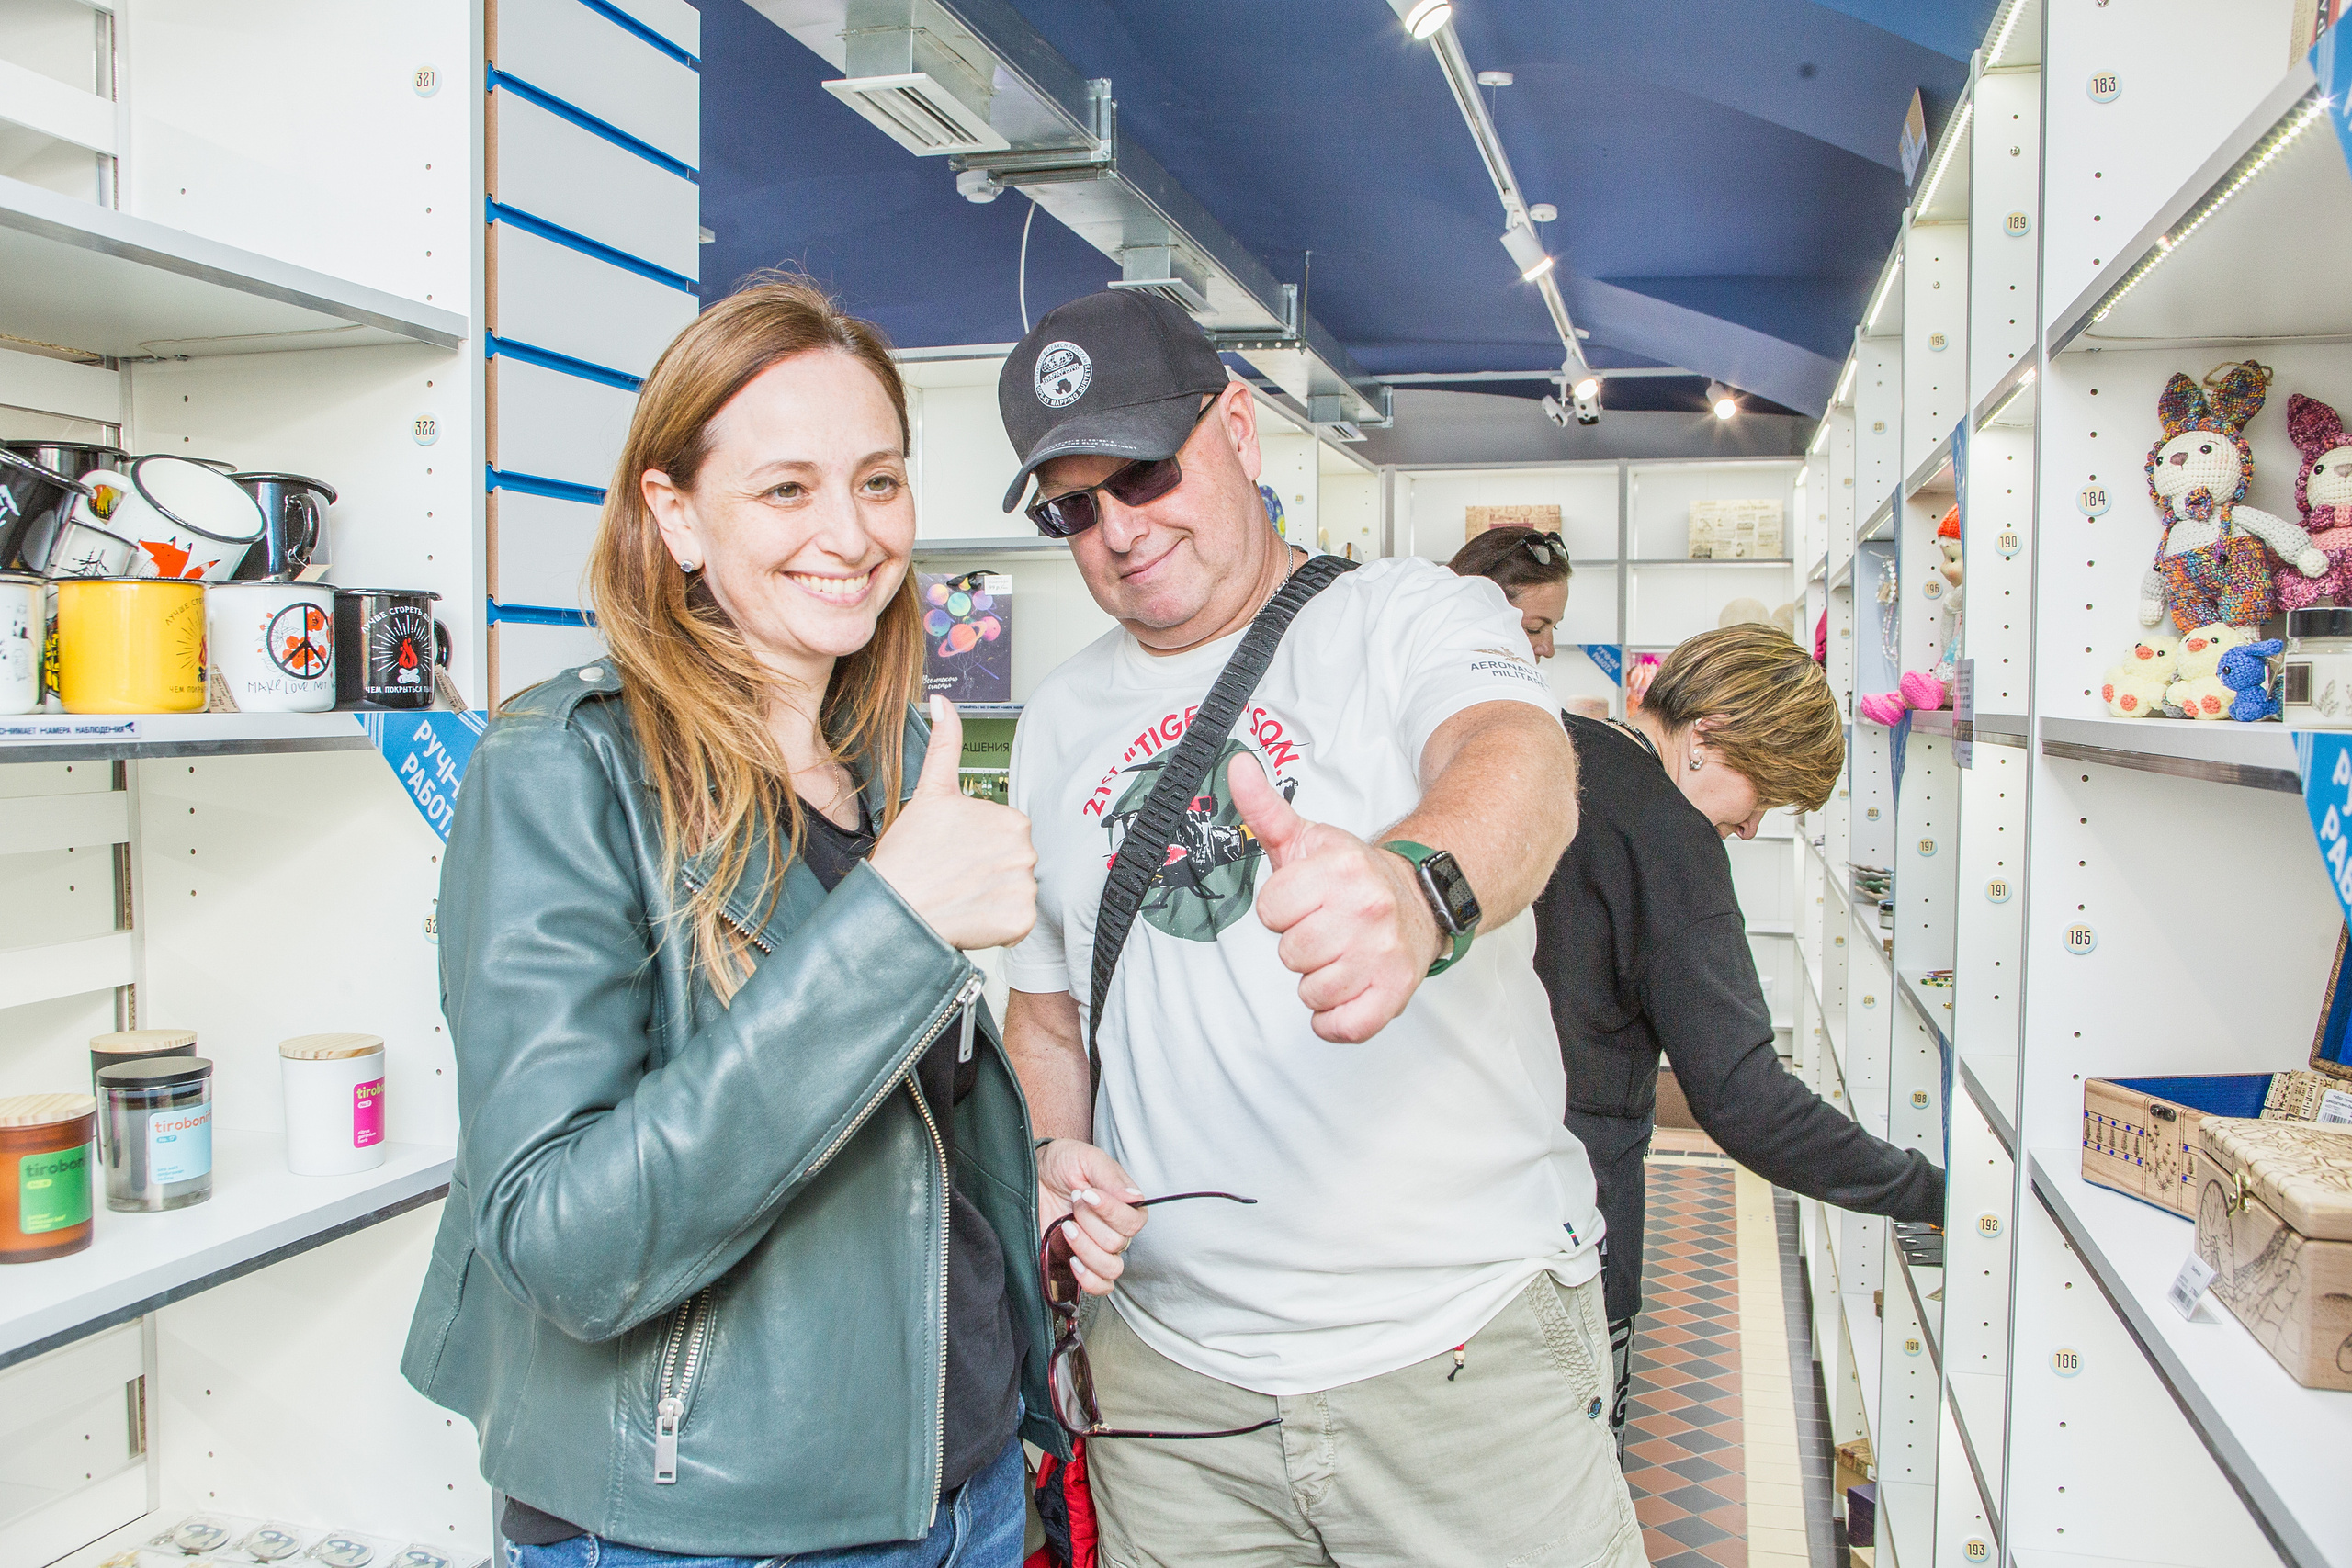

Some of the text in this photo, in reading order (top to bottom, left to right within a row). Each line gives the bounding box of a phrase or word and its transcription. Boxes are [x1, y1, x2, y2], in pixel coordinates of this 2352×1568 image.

[416, 71, 435, 87] 321
[2093, 76, 2116, 94] 183
[2007, 216, 2026, 229] 189
[1931, 335, 1945, 346] 195
[1050, 392, 1080, 406] MAPPING
[1077, 364, 1091, 394] SURVEYS
[415, 420, 435, 436] 322
[2082, 491, 2106, 507] 184
[2000, 536, 2018, 549] 190
[1925, 583, 1939, 593] 196
[361, 611, 388, 634] ЛУЧШЕ
[389, 605, 423, 616] СГОРЕТЬ
[384, 685, 423, 694] ПОКРЫТЬСЯ
[40, 726, 72, 734] КАМЕРА
[75, 725, 125, 734] НАБЛЮДЕНИЯ
[1250, 707, 1301, 776] SQN.
[401, 752, 455, 838] РАБОТ
[1920, 840, 1934, 852] 197
[1990, 884, 2007, 897] 191
[2069, 930, 2091, 945] 185
[1914, 1093, 1928, 1104] 198
[1981, 1218, 1998, 1231] 192
[1906, 1341, 1919, 1351] 199
[2056, 1353, 2077, 1369] 186
[1968, 1543, 1985, 1556] 193
